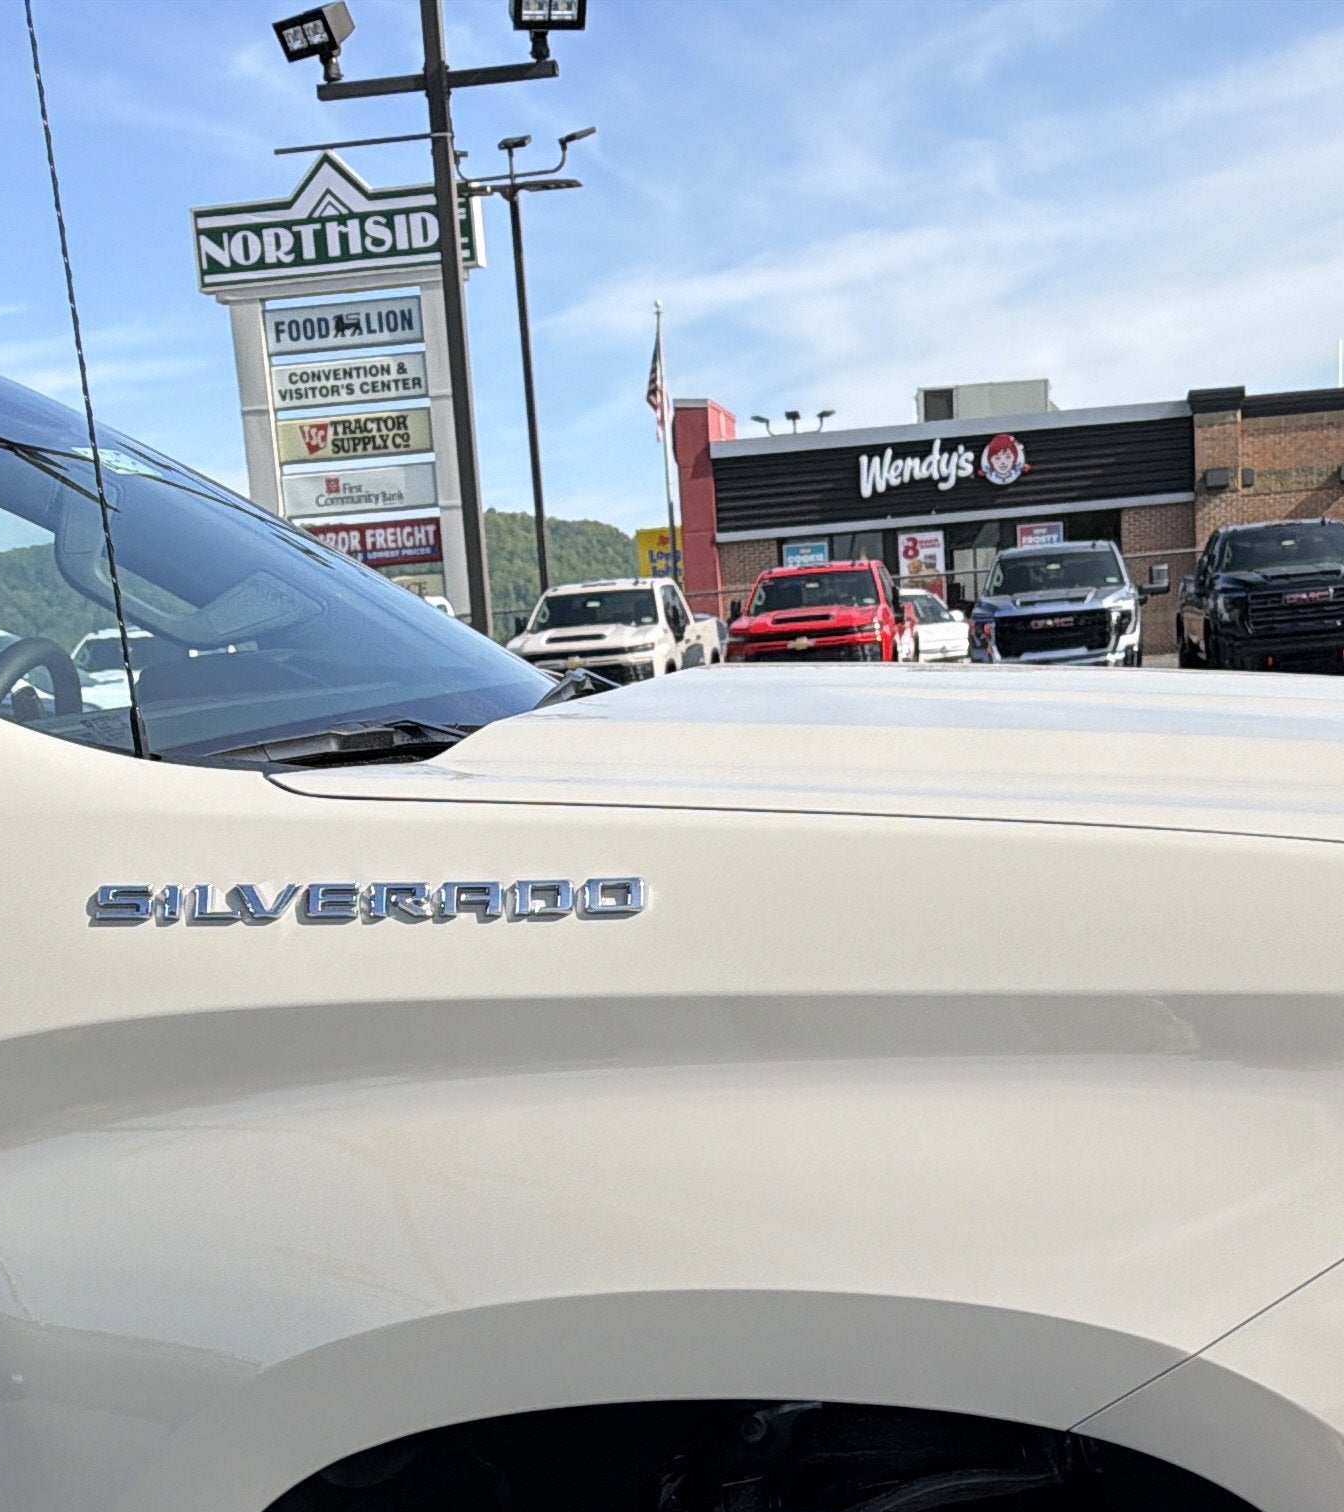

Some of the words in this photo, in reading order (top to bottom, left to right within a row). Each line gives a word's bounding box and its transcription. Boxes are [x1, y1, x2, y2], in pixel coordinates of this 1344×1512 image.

[273, 317, 330, 344] FOOD
[364, 308, 414, 335] LION
[288, 364, 391, 385] CONVENTION
[396, 361, 408, 375] &
[278, 383, 355, 401] VISITOR'S
[359, 376, 423, 395] CENTER
[330, 414, 409, 437] TRACTOR
[331, 433, 390, 454] SUPPLY
[858, 438, 974, 498] Wendy's
[315, 490, 380, 508] Community
[364, 524, 436, 551] FREIGHT
[90, 877, 649, 924] SILVERADO
